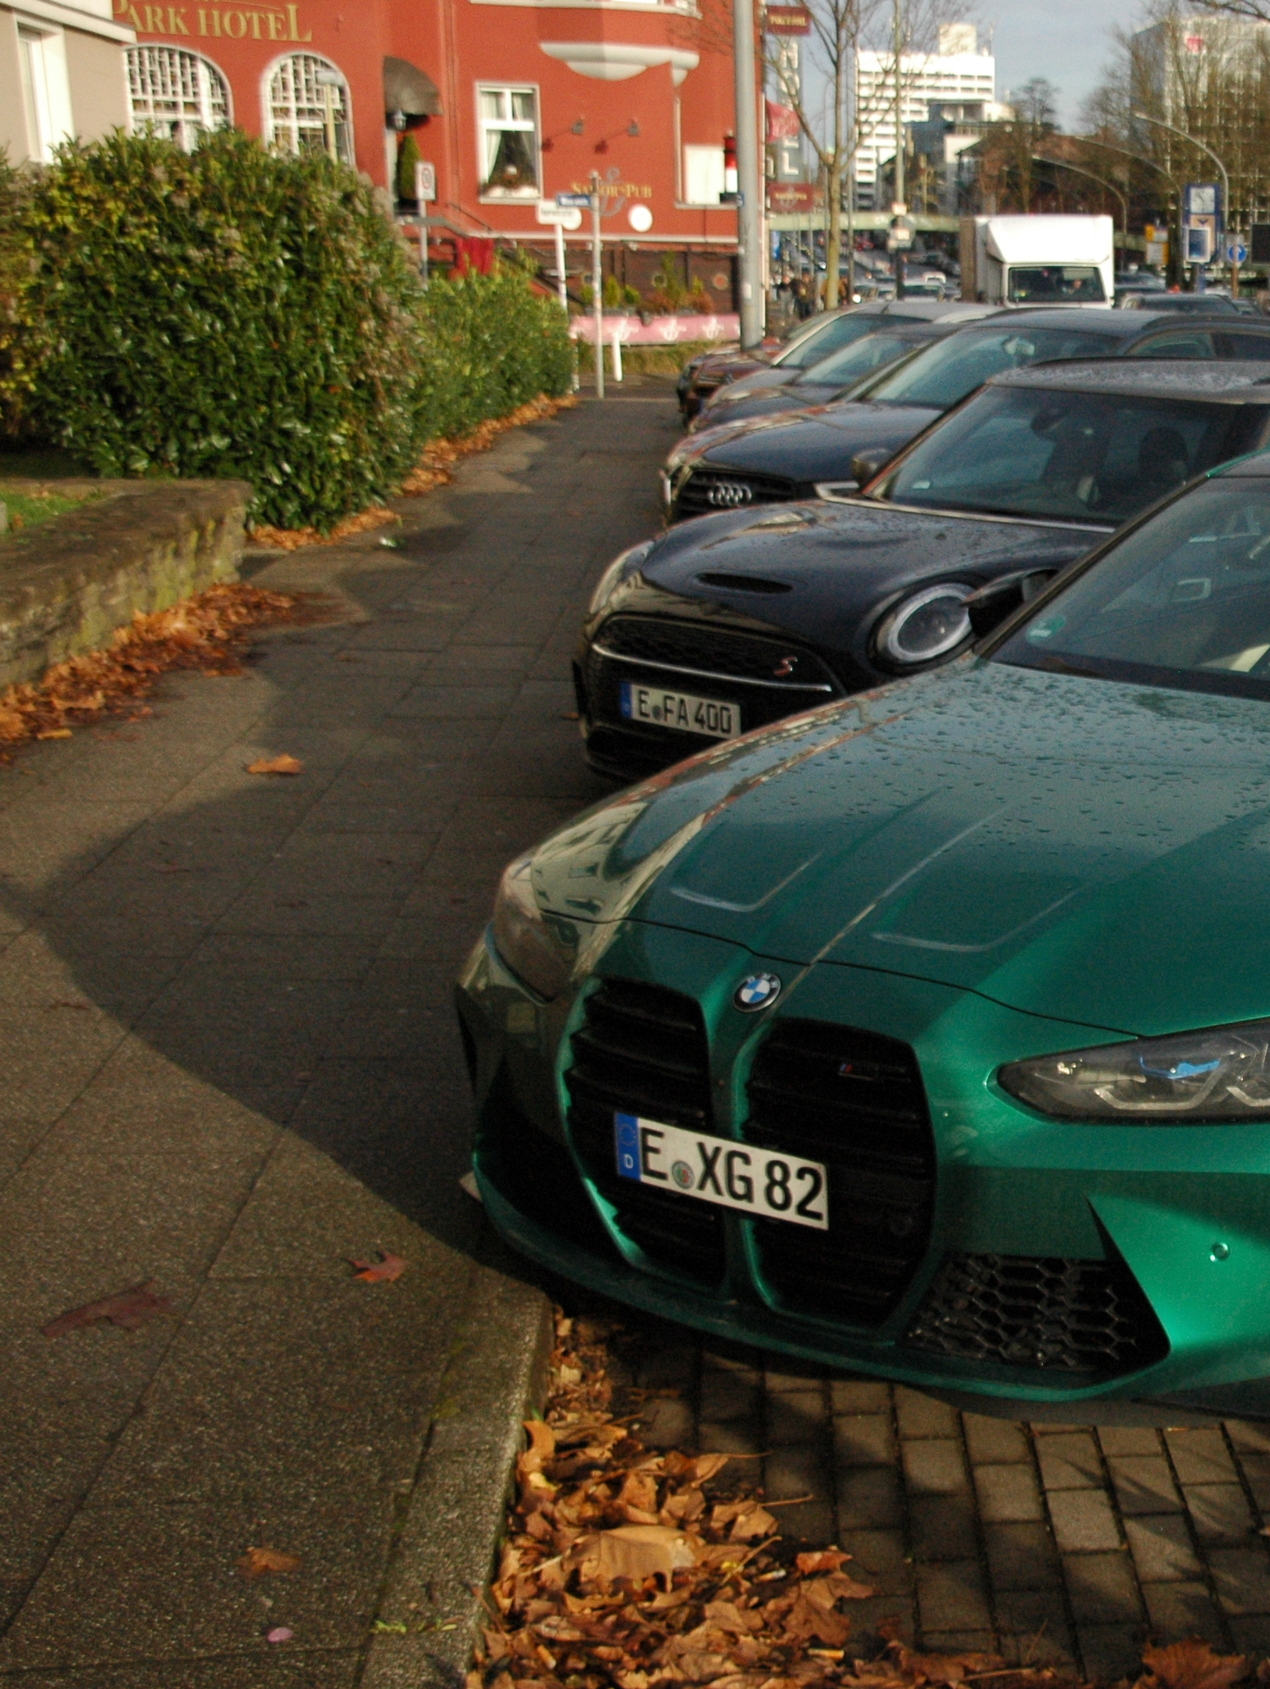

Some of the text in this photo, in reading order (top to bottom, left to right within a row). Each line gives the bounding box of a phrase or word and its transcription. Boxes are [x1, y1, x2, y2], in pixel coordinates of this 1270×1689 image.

[113, 0, 313, 42] ARK HOTEL
[778, 41, 801, 176] HOL
[626, 183, 653, 199] PUB
[637, 689, 732, 735] E FA 400
[641, 1127, 824, 1221] E XG 82
